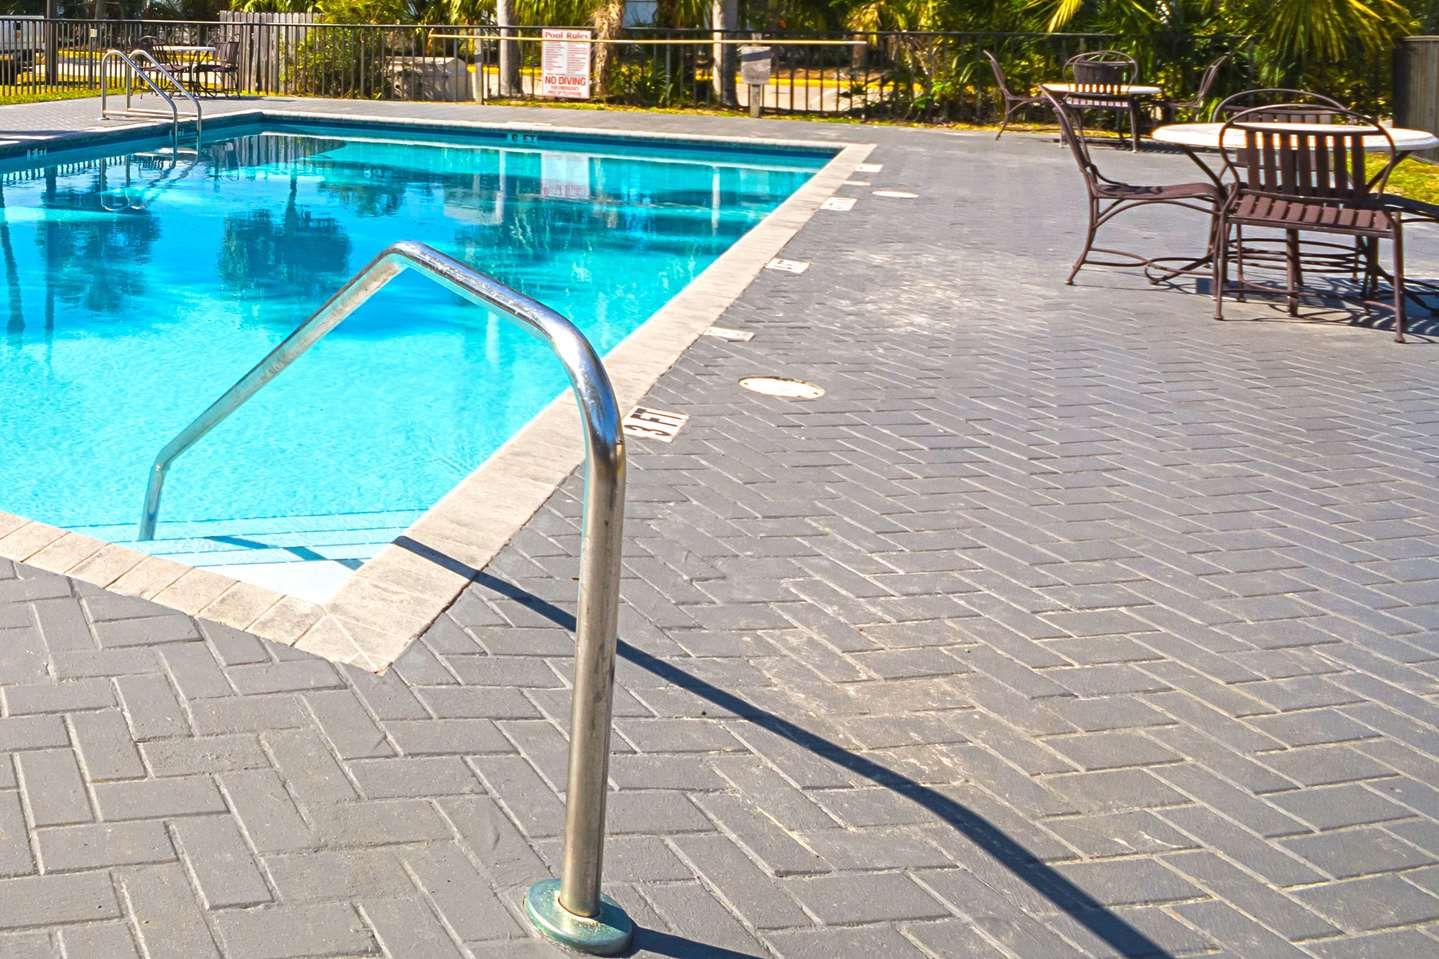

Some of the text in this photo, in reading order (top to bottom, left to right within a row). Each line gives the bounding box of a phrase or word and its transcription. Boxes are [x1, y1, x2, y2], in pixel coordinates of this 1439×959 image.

[545, 31, 589, 39] Pool Rules
[545, 75, 586, 86] NO DIVING
[629, 407, 683, 428] FT
